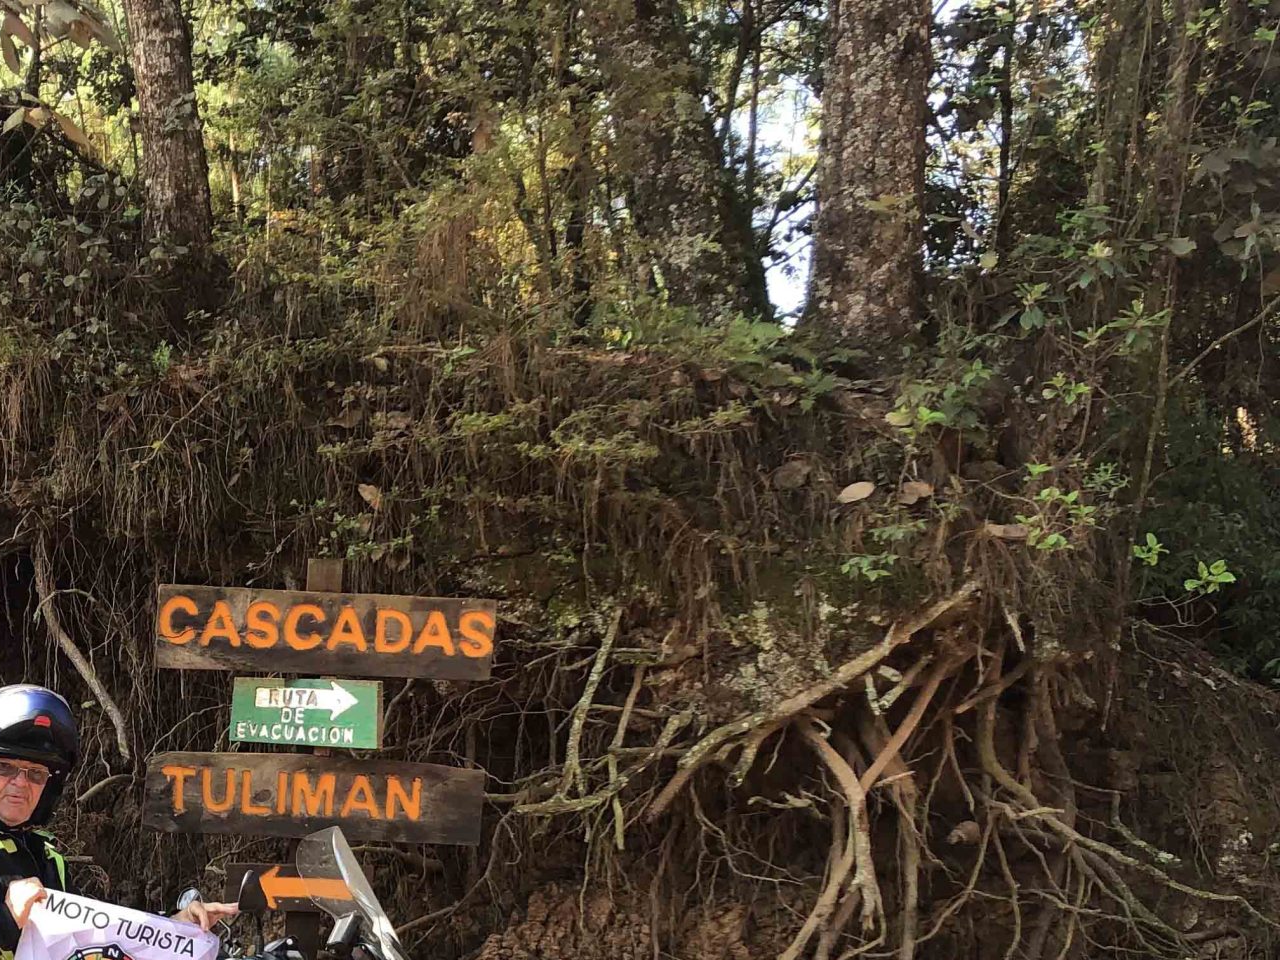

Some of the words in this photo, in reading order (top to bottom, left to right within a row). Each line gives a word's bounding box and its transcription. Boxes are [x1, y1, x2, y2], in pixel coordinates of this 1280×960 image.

[159, 595, 494, 658] CASCADAS
[269, 688, 318, 706] RUTA
[281, 707, 304, 724] DE
[236, 722, 354, 744] EVACUACION
[162, 764, 423, 821] TULIMAN
[46, 894, 110, 929] MOTO
[116, 918, 194, 958] TURISTA
[108, 948, 119, 958] N
